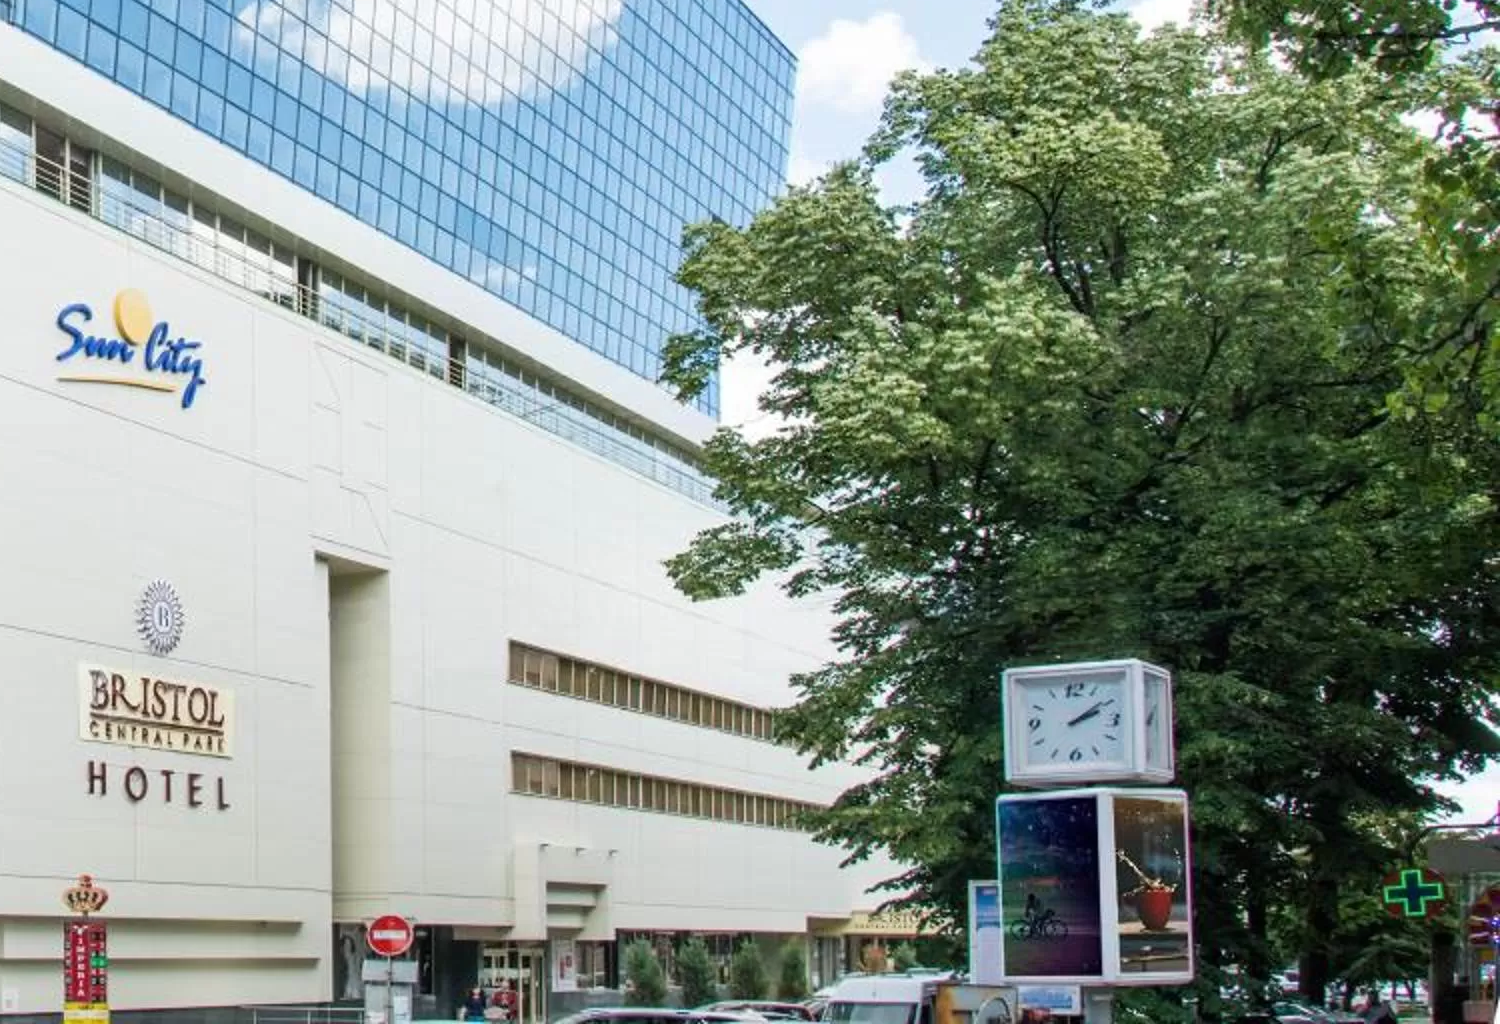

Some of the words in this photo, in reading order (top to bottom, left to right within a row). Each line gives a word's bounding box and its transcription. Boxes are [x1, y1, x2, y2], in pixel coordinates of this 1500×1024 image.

[56, 303, 135, 364] Sun
[145, 321, 207, 409] City
[88, 669, 225, 728] BRISTOL
[1063, 682, 1085, 698] 12
[88, 719, 174, 749] CENTRAL
[182, 731, 226, 753] PARK
[1028, 719, 1041, 730] 9
[1109, 713, 1121, 726] 3
[1069, 747, 1083, 761] 6
[87, 760, 231, 812] HOTEL
